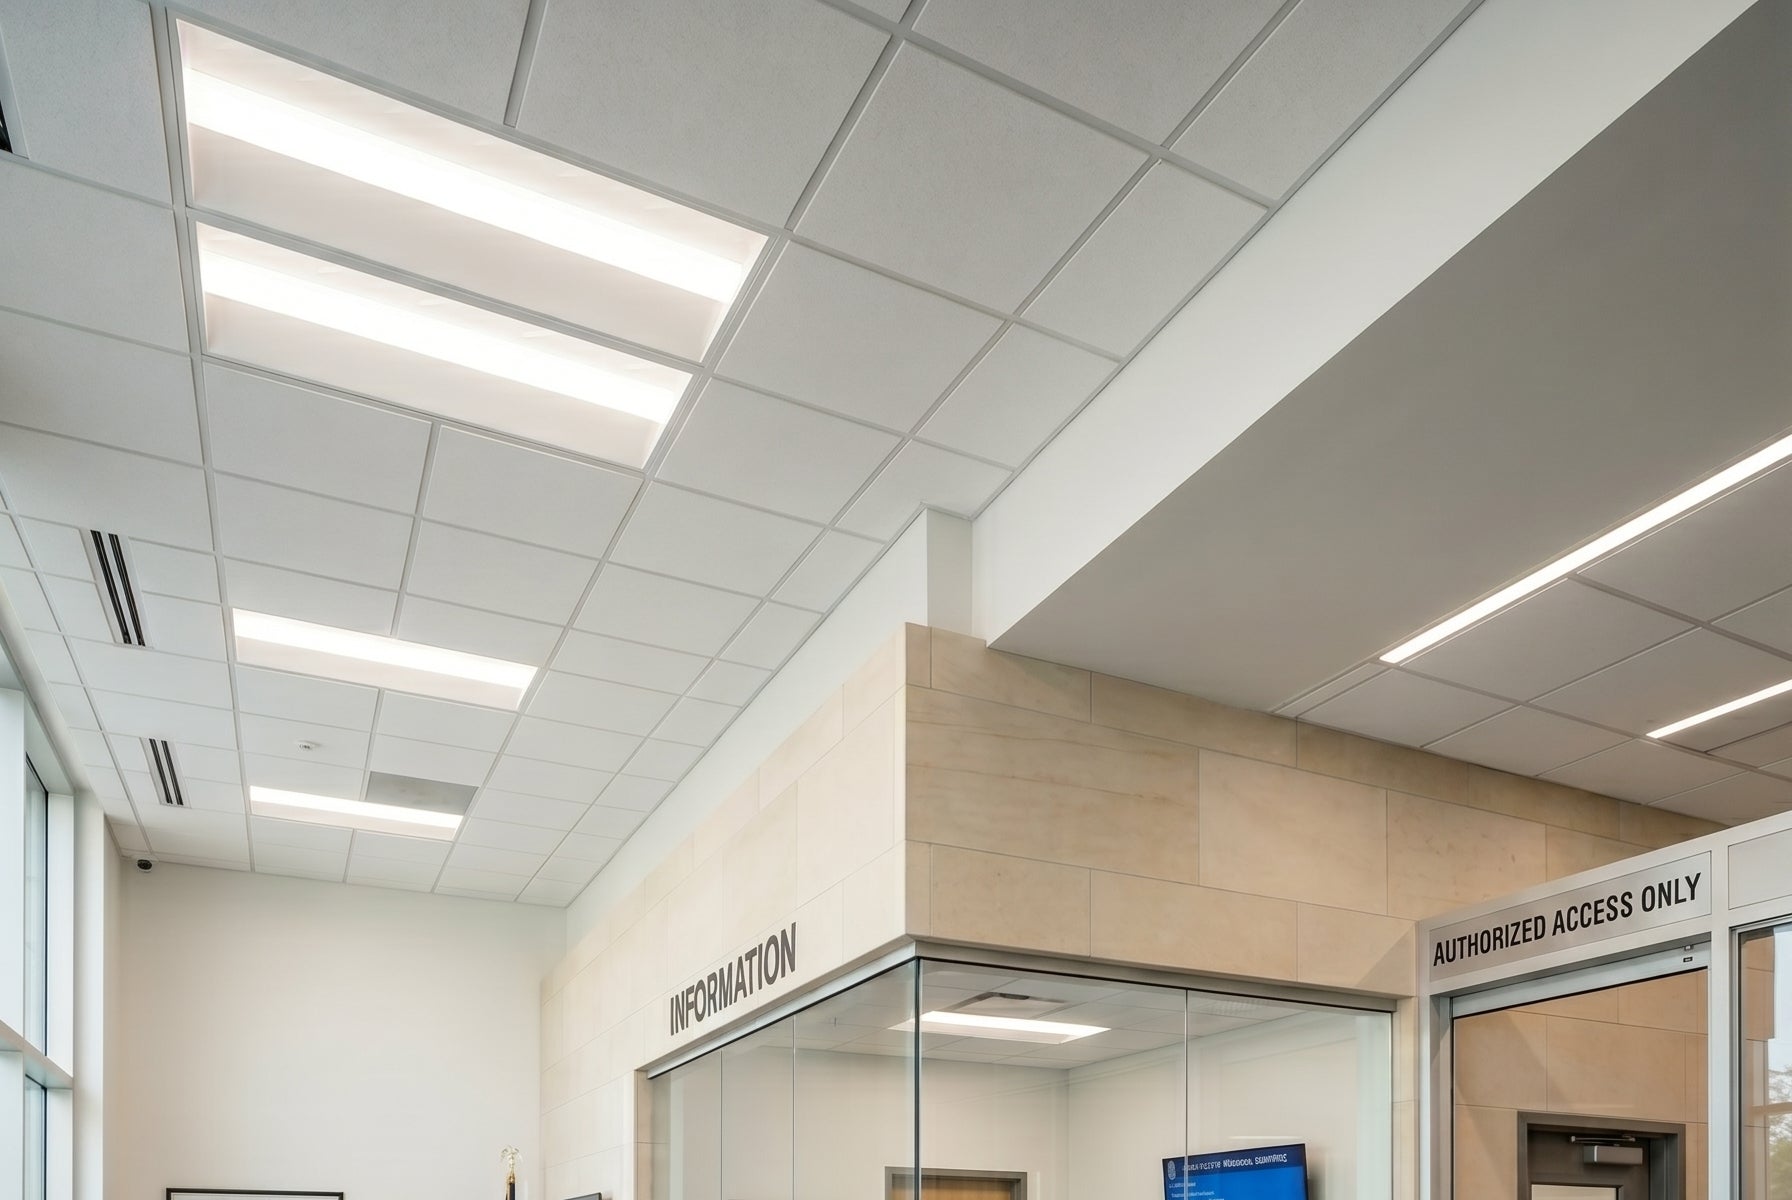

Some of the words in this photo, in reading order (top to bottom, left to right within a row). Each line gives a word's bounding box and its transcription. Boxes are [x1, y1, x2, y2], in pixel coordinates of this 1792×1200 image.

[1433, 915, 1546, 966] AUTHORIZED
[1552, 891, 1633, 936] ACCESS
[1641, 872, 1702, 912] ONLY
[670, 922, 796, 1036] INFORMATION
